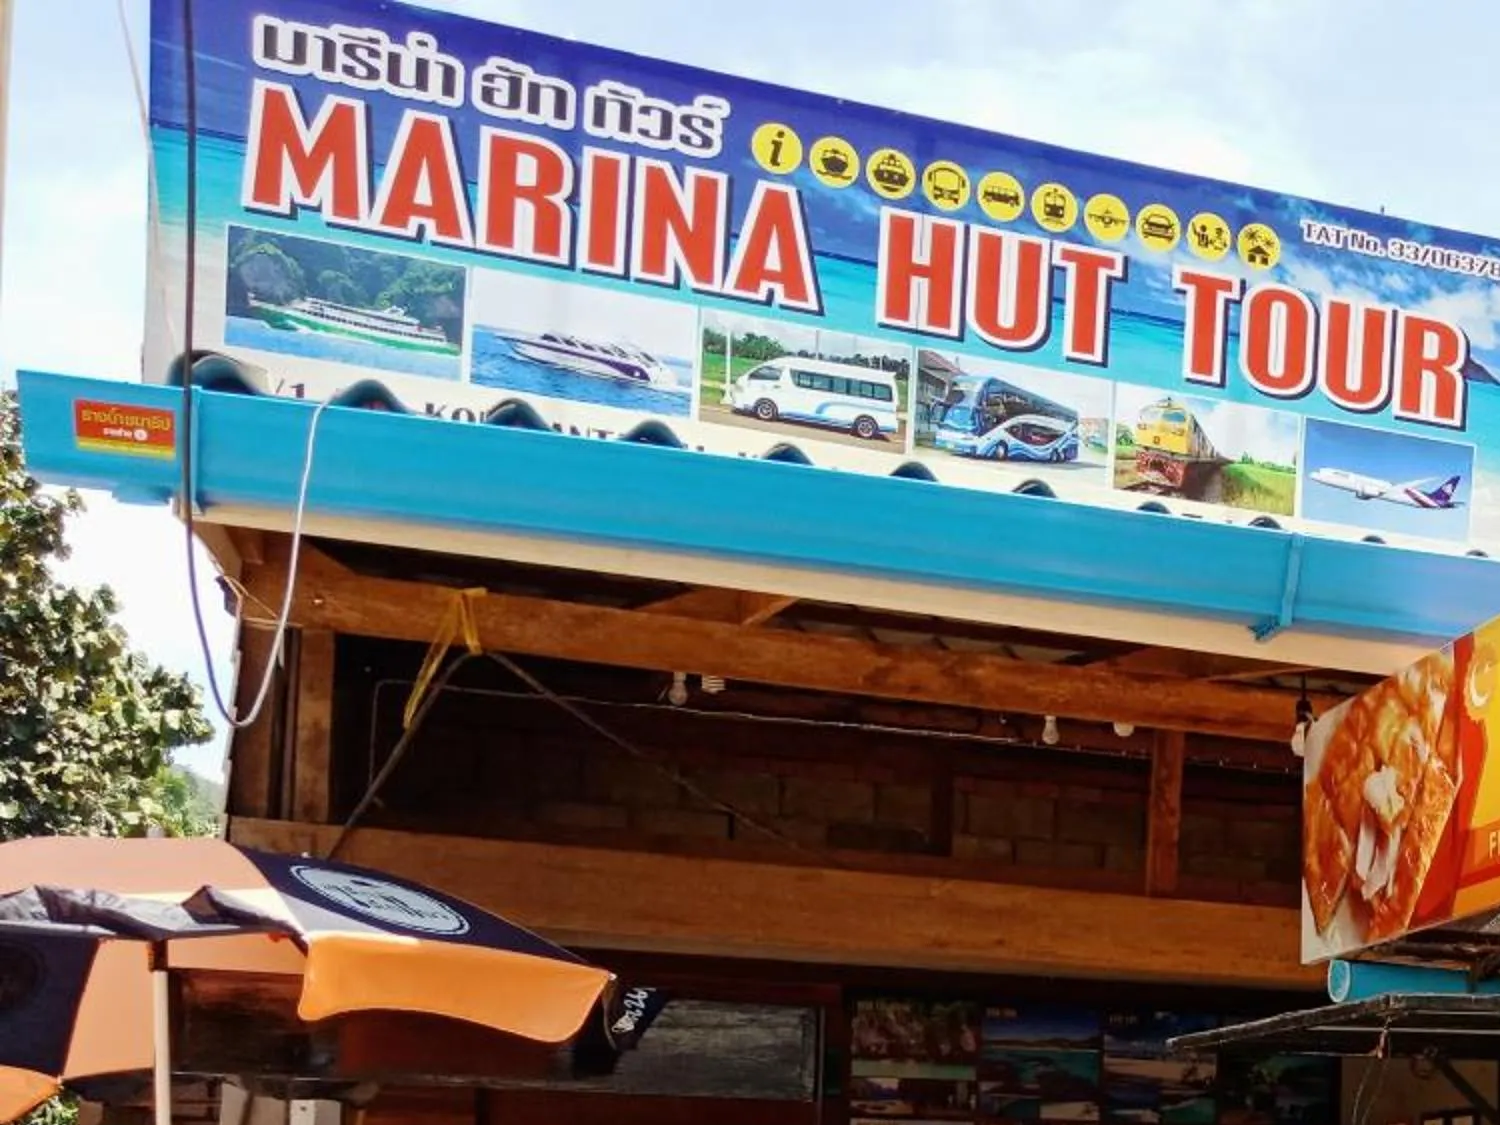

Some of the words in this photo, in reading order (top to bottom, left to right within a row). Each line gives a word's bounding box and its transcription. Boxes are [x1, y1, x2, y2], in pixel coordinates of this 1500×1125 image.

[246, 84, 821, 311] MARINA
[881, 209, 1124, 363] HUT
[1176, 268, 1468, 428] TOUR
[1304, 222, 1346, 248] TAT
[1348, 231, 1384, 256] No.
